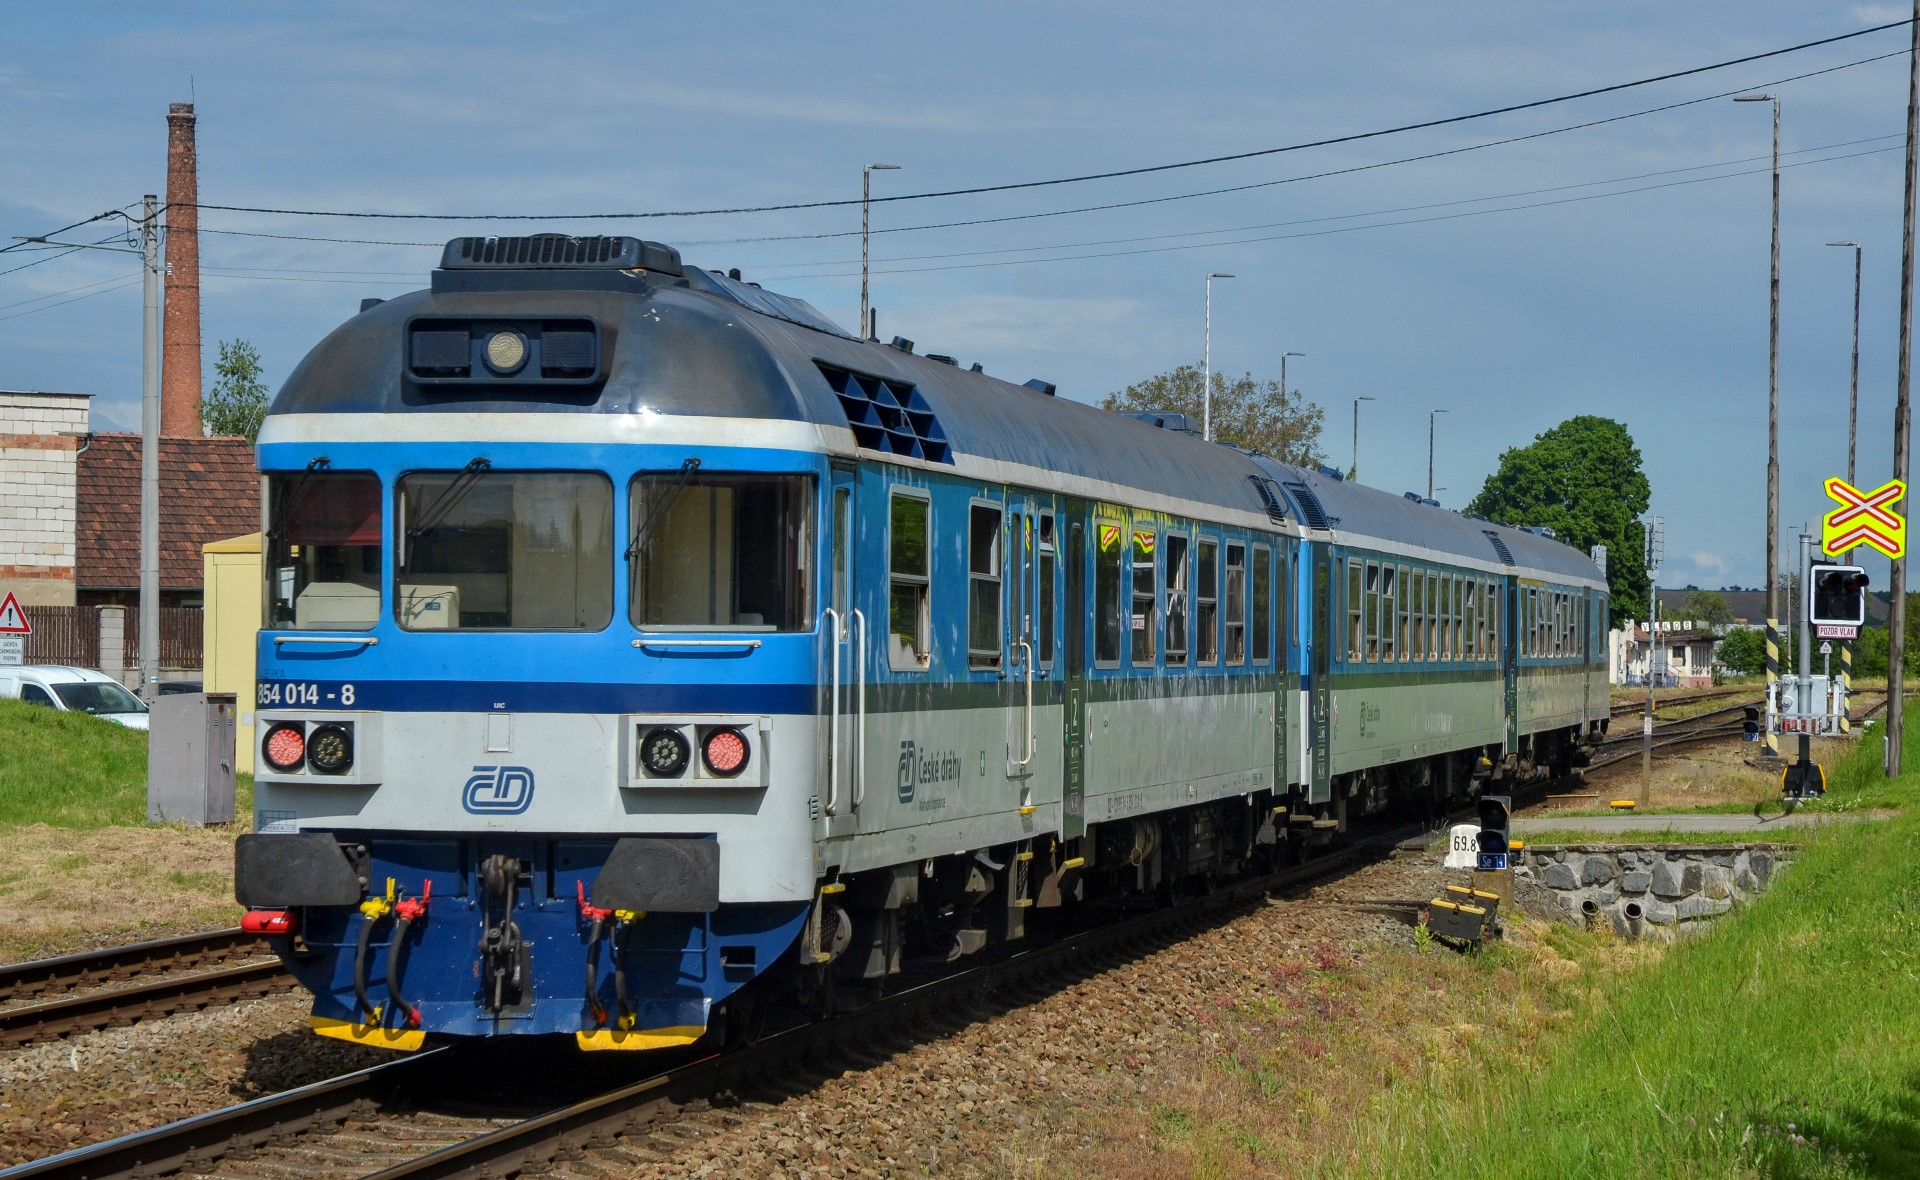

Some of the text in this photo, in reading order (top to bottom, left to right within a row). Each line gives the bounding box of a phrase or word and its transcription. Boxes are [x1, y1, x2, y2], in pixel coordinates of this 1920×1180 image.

[1820, 626, 1855, 636] POZOR VLAK
[257, 683, 281, 704] 854
[285, 683, 319, 705] 014
[341, 684, 355, 705] 8
[1072, 697, 1078, 727] 2
[1319, 695, 1324, 716] 2
[919, 747, 961, 788] České dráhy
[1454, 835, 1477, 852] 69.8
[1482, 855, 1503, 868] Se 14
